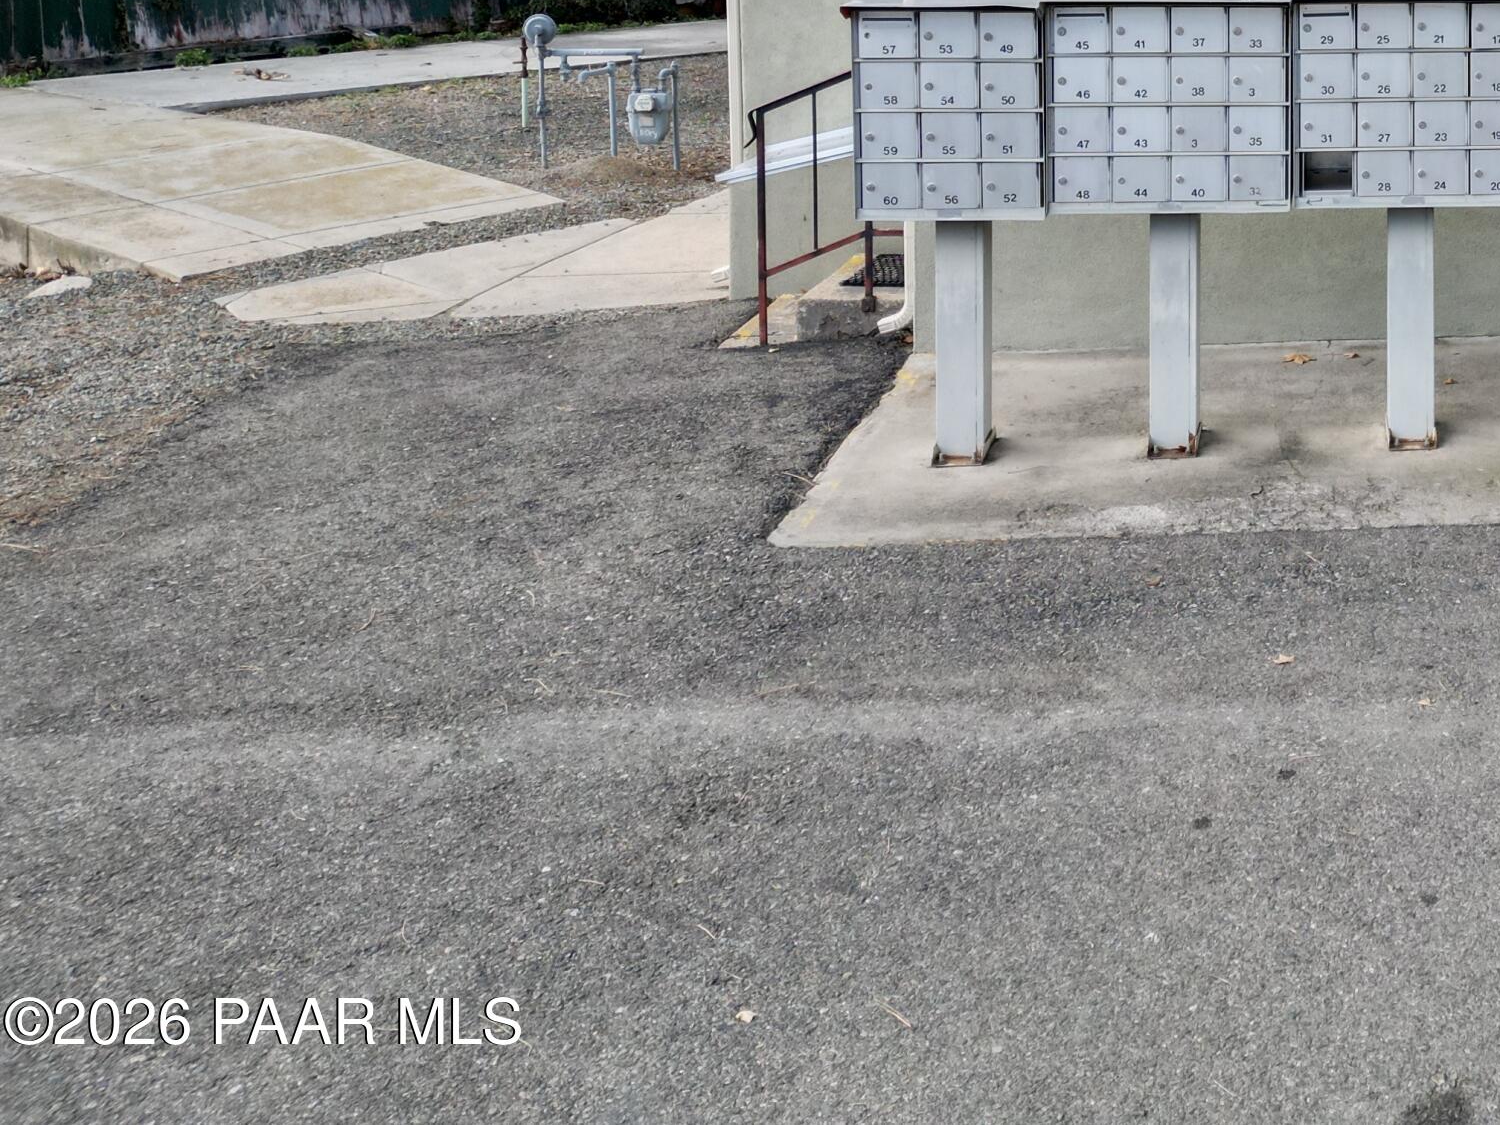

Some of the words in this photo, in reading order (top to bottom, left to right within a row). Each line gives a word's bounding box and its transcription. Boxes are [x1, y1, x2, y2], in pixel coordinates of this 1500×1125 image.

[1134, 39, 1146, 49] 41
[1192, 37, 1206, 48] 37
[1248, 38, 1263, 49] 33
[1320, 35, 1334, 45] 29
[1376, 34, 1390, 45] 25
[1433, 34, 1445, 44] 21
[882, 44, 897, 55] 57
[938, 44, 953, 55] 53
[999, 44, 1014, 54] 49
[1075, 40, 1090, 50] 45
[1191, 86, 1205, 97] 38
[1321, 85, 1335, 95] 30
[1377, 84, 1391, 94] 26
[1433, 83, 1447, 94] 22
[1075, 89, 1091, 100] 46
[1134, 89, 1148, 99] 42
[883, 95, 898, 106] 58
[940, 95, 955, 106] 54
[1001, 95, 1016, 106] 50
[1248, 136, 1263, 147] 35
[1321, 133, 1333, 144] 31
[1377, 133, 1391, 143] 27
[1434, 132, 1448, 142] 23
[1076, 139, 1090, 149] 47
[1134, 138, 1148, 148] 43
[883, 146, 898, 156] 59
[942, 145, 957, 155] 55
[1002, 144, 1013, 155] 51
[1377, 182, 1392, 192] 28
[1433, 180, 1447, 190] 24
[1003, 193, 1017, 203] 52
[1075, 190, 1091, 200] 48
[1133, 188, 1148, 198] 44
[1190, 188, 1206, 198] 40
[883, 195, 899, 206] 60
[944, 194, 959, 205] 56
